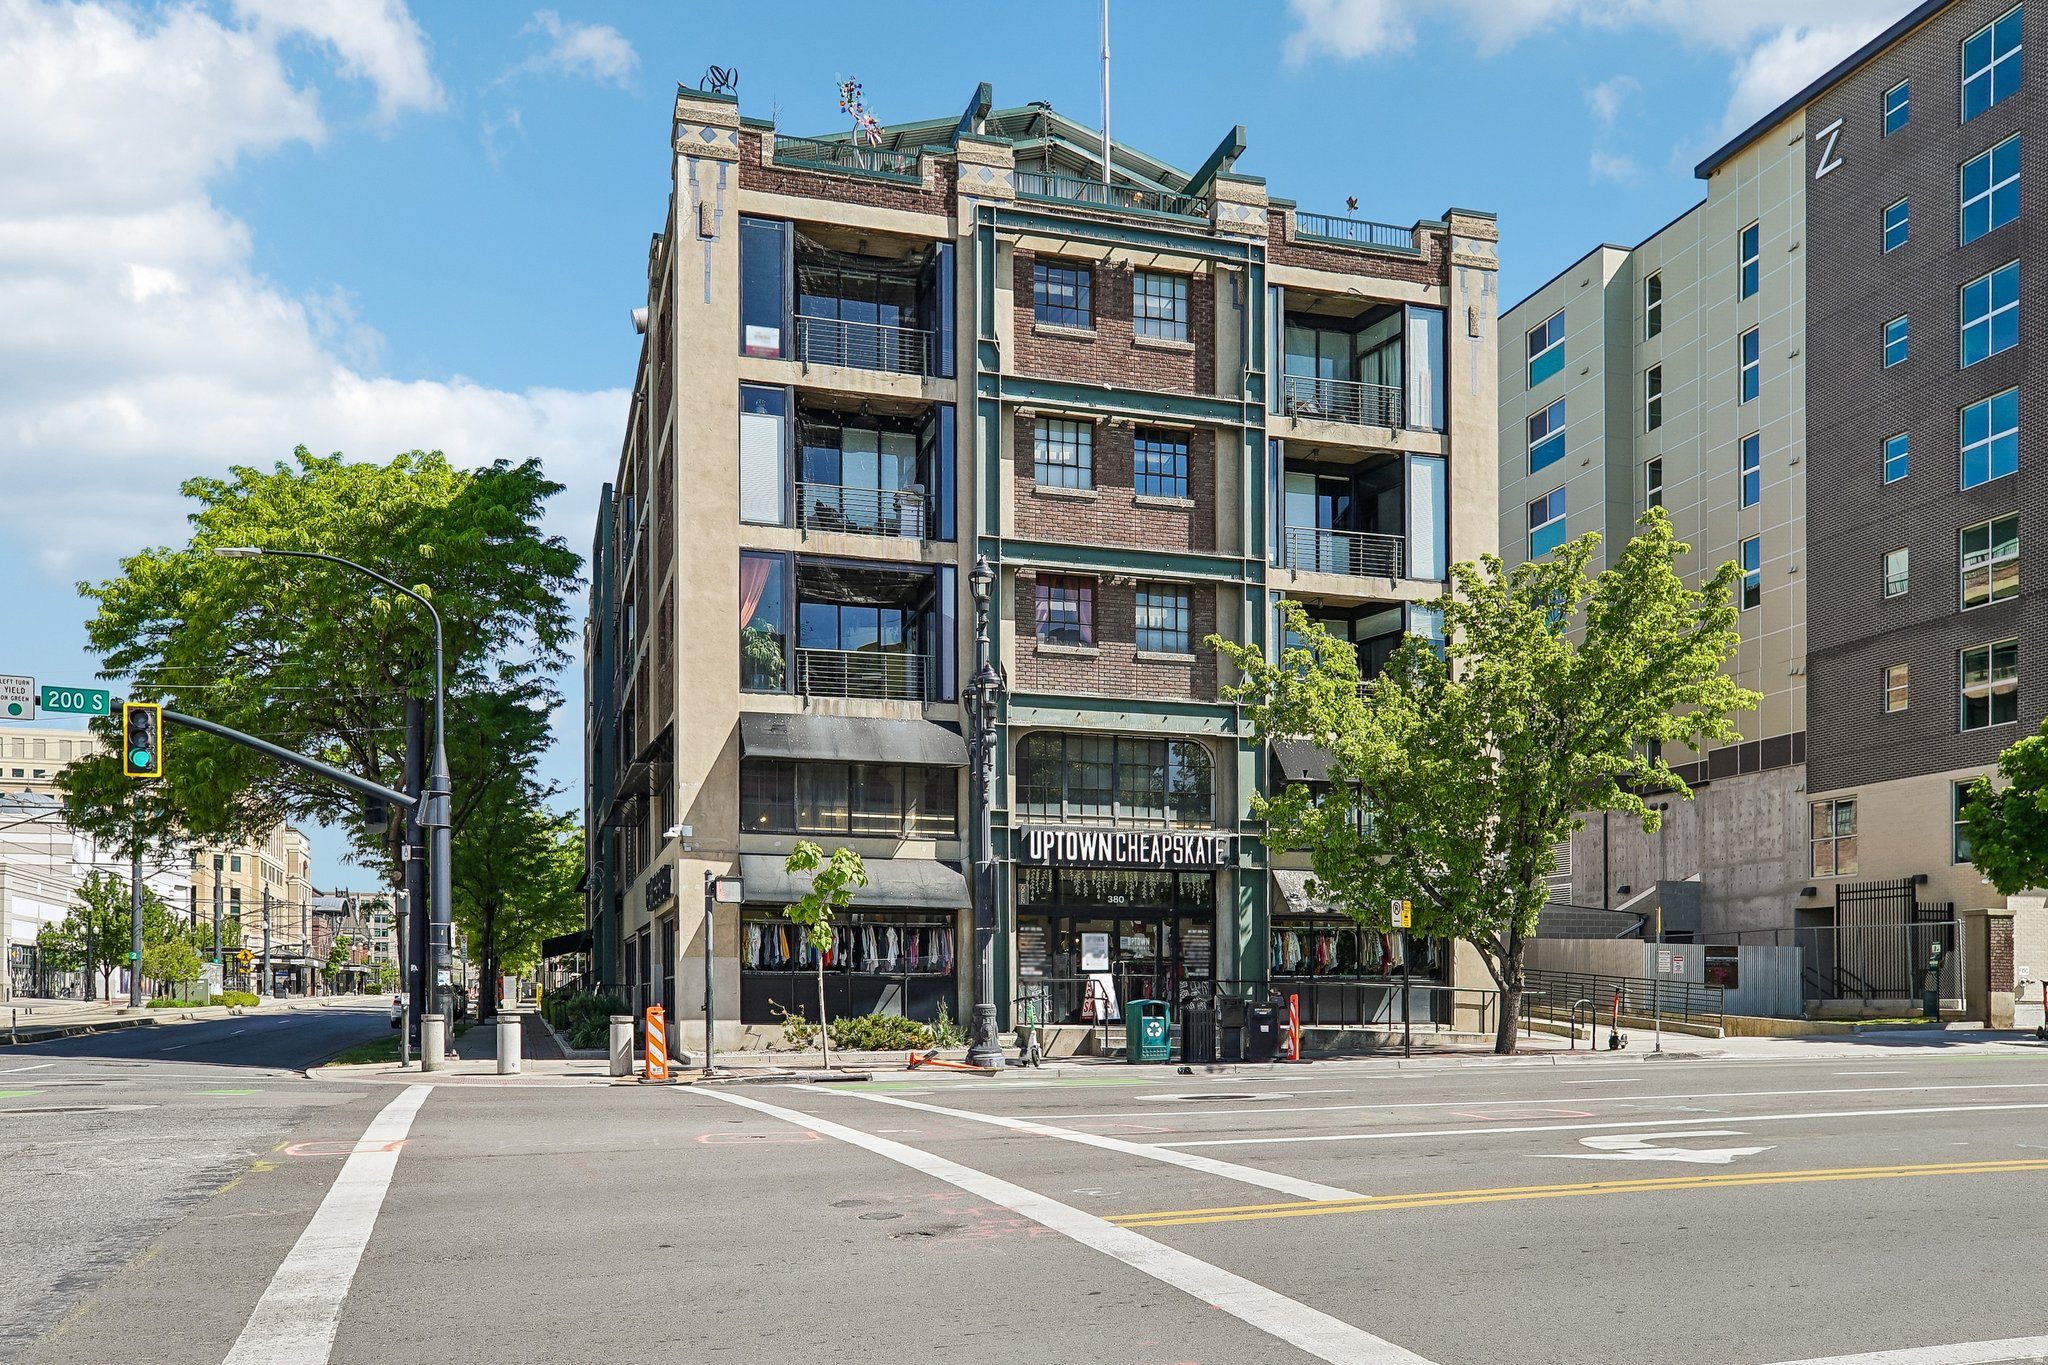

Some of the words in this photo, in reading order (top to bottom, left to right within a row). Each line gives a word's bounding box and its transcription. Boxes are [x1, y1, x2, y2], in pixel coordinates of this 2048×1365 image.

[1815, 117, 1843, 180] Z
[4, 686, 26, 695] YIELD
[48, 690, 85, 709] 200
[92, 694, 103, 711] S
[1030, 830, 1113, 862] UPTOWN
[1116, 833, 1225, 865] CHEAPSKATE
[1107, 895, 1125, 904] 380
[131, 952, 137, 960] 2
